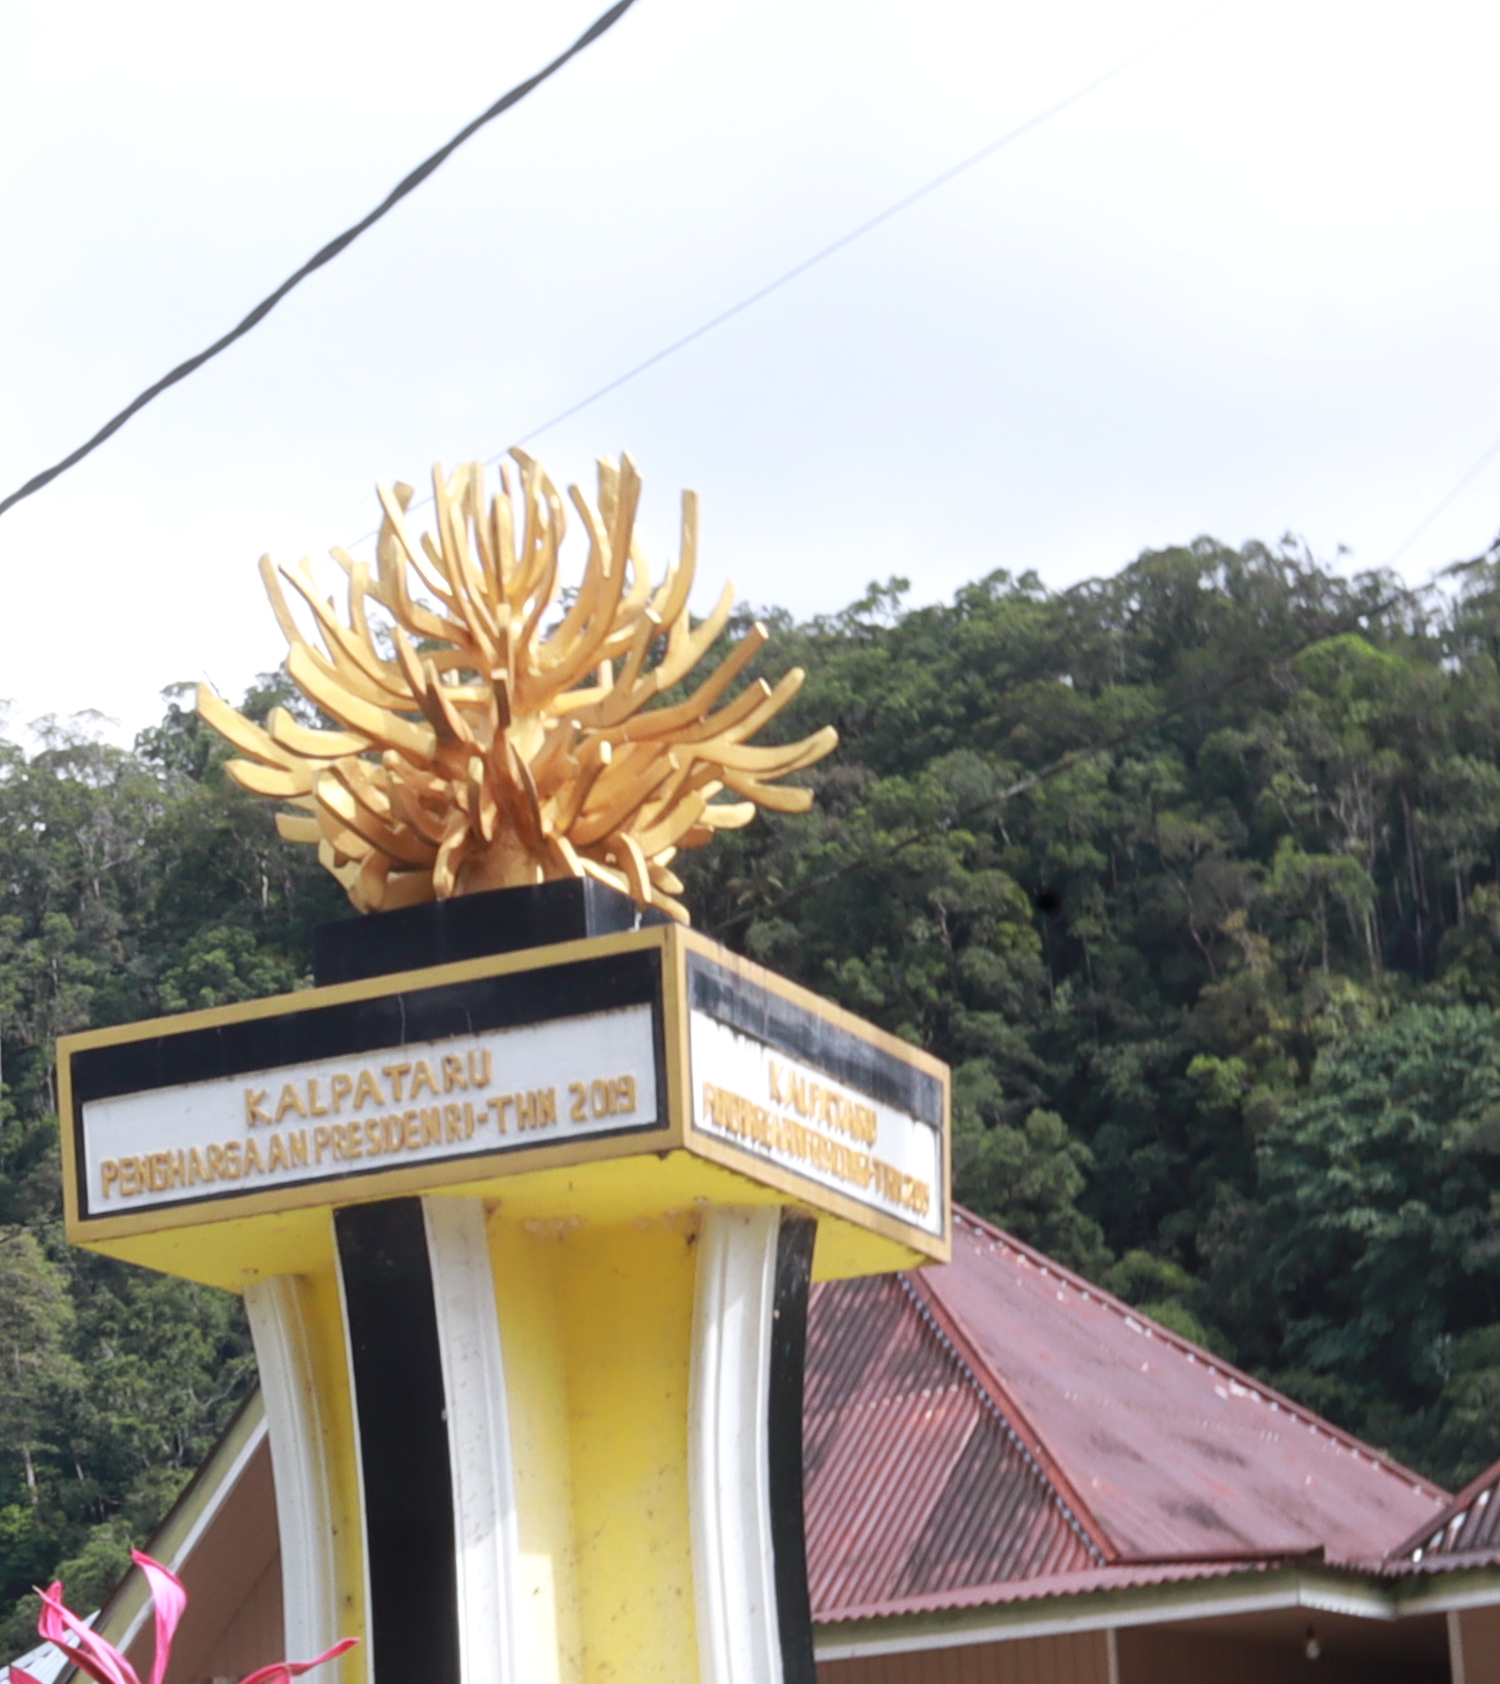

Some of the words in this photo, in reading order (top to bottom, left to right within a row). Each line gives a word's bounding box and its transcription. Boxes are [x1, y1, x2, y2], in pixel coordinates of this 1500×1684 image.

[101, 1129, 308, 1198] PENGHARGAAN
[313, 1106, 441, 1164] PRESIDEN
[568, 1074, 637, 1122] 2019
[245, 1049, 493, 1127] KALPATARU
